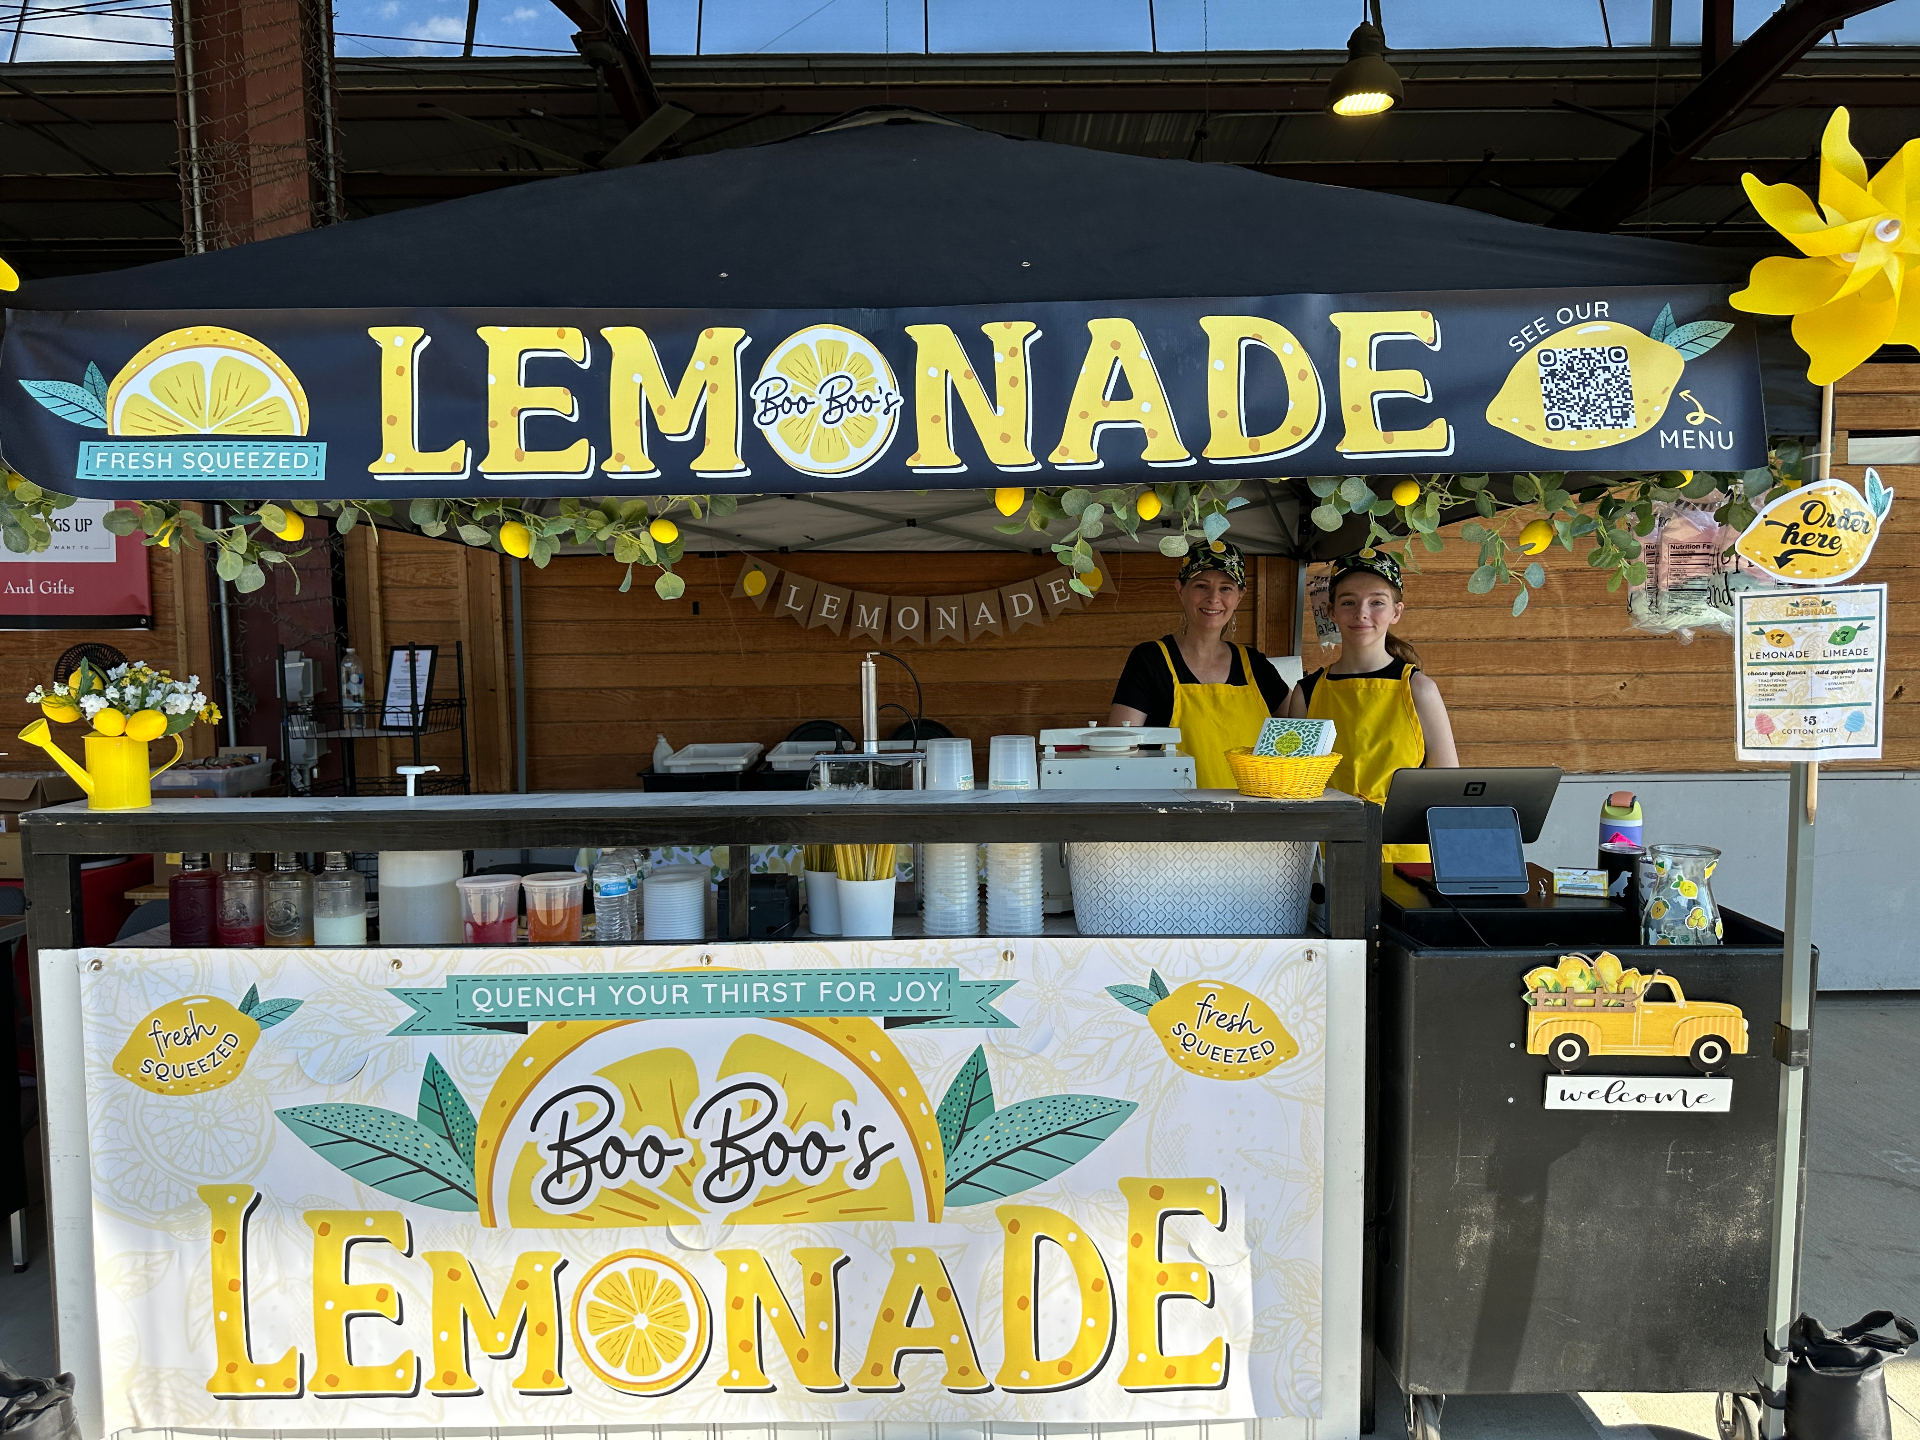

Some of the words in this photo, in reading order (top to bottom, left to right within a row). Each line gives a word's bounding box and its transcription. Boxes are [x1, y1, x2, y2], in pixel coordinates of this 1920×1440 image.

[1508, 317, 1550, 352] SEE
[1556, 301, 1610, 325] OUR
[754, 376, 816, 425] Boo
[818, 374, 900, 425] Boo's
[1660, 429, 1734, 450] MENU
[96, 452, 172, 470] FRESH
[182, 452, 309, 473] SQUEEZED
[75, 519, 93, 532] UP
[1800, 500, 1871, 534] Order
[1670, 543, 1701, 551] Nutrition
[1765, 520, 1842, 550] here
[3, 578, 35, 595] And
[39, 578, 75, 595] Gifts
[784, 578, 1072, 631] LEMONADE
[1785, 603, 1837, 617] LEMONADE
[1770, 633, 1785, 644] $7
[1835, 630, 1850, 642] $7
[1749, 650, 1810, 660] LEMONADE
[1822, 647, 1869, 658] LIMEADE
[1816, 726, 1838, 735] CANDY
[471, 986, 596, 1013] QUENCH
[608, 984, 690, 1006] YOUR
[702, 982, 807, 1004] THIRST
[819, 981, 877, 1003] FOR
[889, 980, 944, 1003] JOY
[1196, 993, 1263, 1035] fresh
[148, 1009, 217, 1058] fresh
[1172, 1022, 1275, 1064] SQUEEZED
[140, 1033, 239, 1082] SQUEEZED
[1559, 1080, 1716, 1109] welcome
[530, 1084, 684, 1205] Boo
[692, 1082, 895, 1204] Boo's
